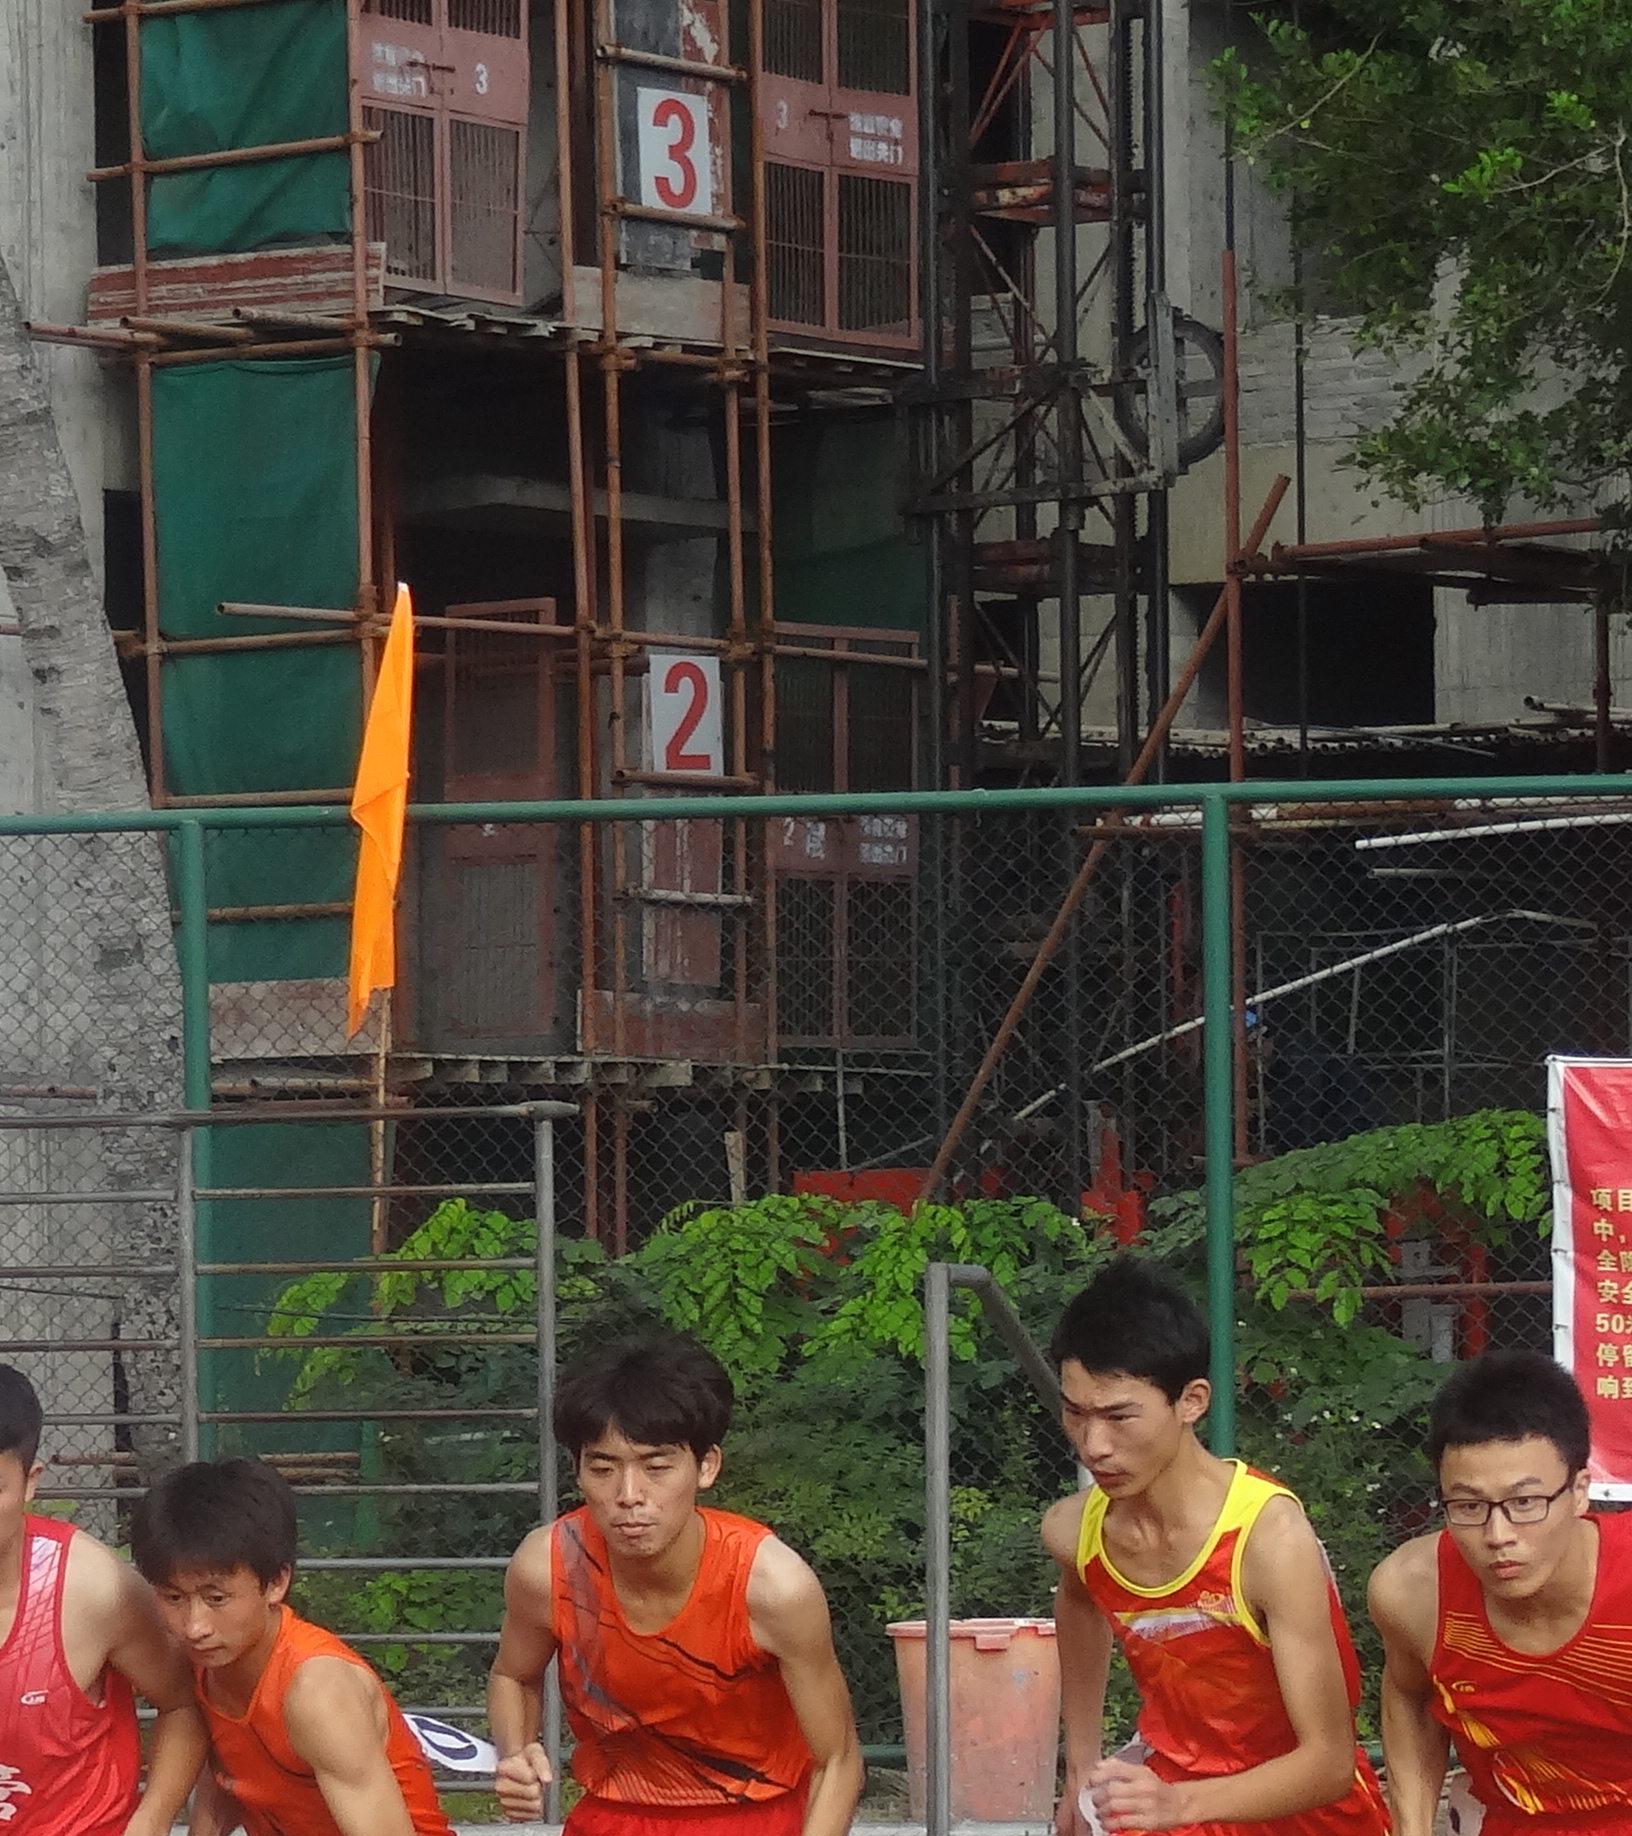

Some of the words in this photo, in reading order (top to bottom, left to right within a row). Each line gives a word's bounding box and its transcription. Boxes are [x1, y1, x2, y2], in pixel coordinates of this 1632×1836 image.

[474, 62, 489, 95] 3
[652, 97, 697, 209] 3
[665, 661, 711, 770] 2
